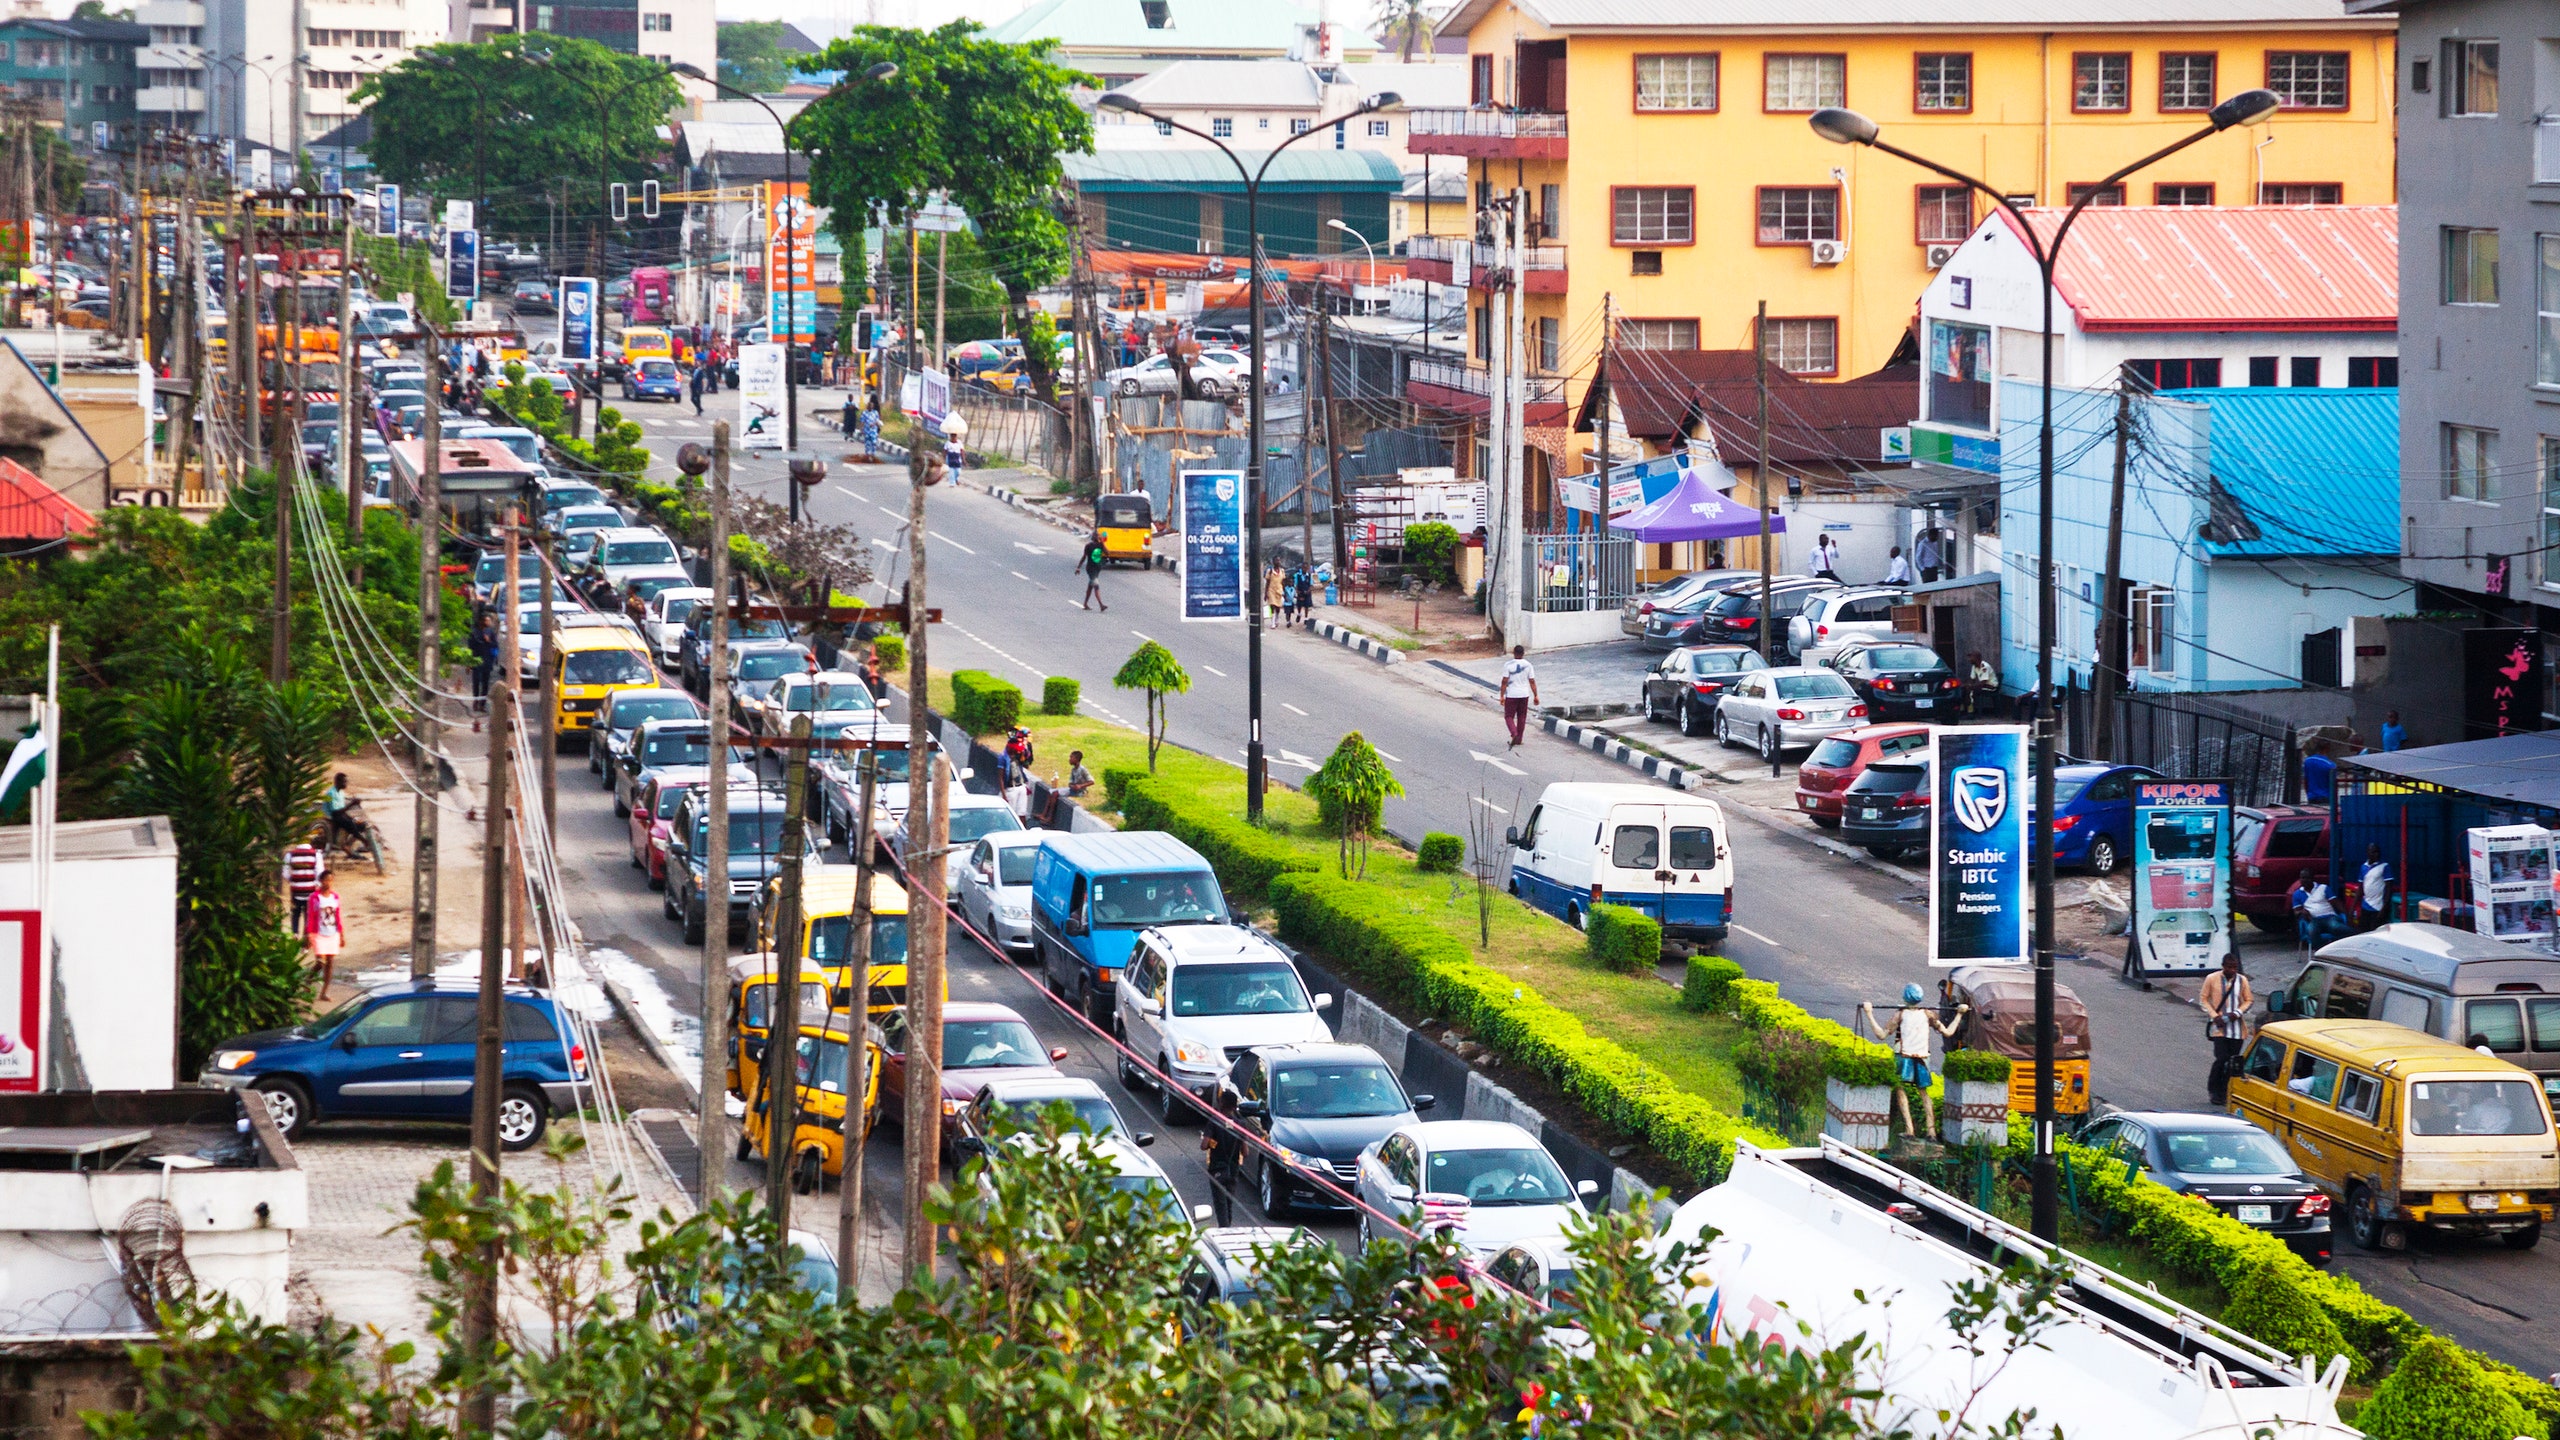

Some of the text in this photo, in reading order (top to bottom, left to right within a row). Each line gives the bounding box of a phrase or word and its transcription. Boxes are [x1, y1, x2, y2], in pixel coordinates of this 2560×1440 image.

[1204, 525, 1220, 534] Call
[1187, 534, 1237, 544] 01-271 6000
[1200, 545, 1224, 554] today
[2142, 784, 2221, 798] KIPOR
[2155, 797, 2207, 805] POWER
[1948, 848, 2007, 864] Stanbic
[1962, 868, 1998, 884] IBTC
[2491, 886, 2527, 894] FIRMAN
[1960, 891, 1996, 901] Pension
[1957, 904, 2002, 915] Managers
